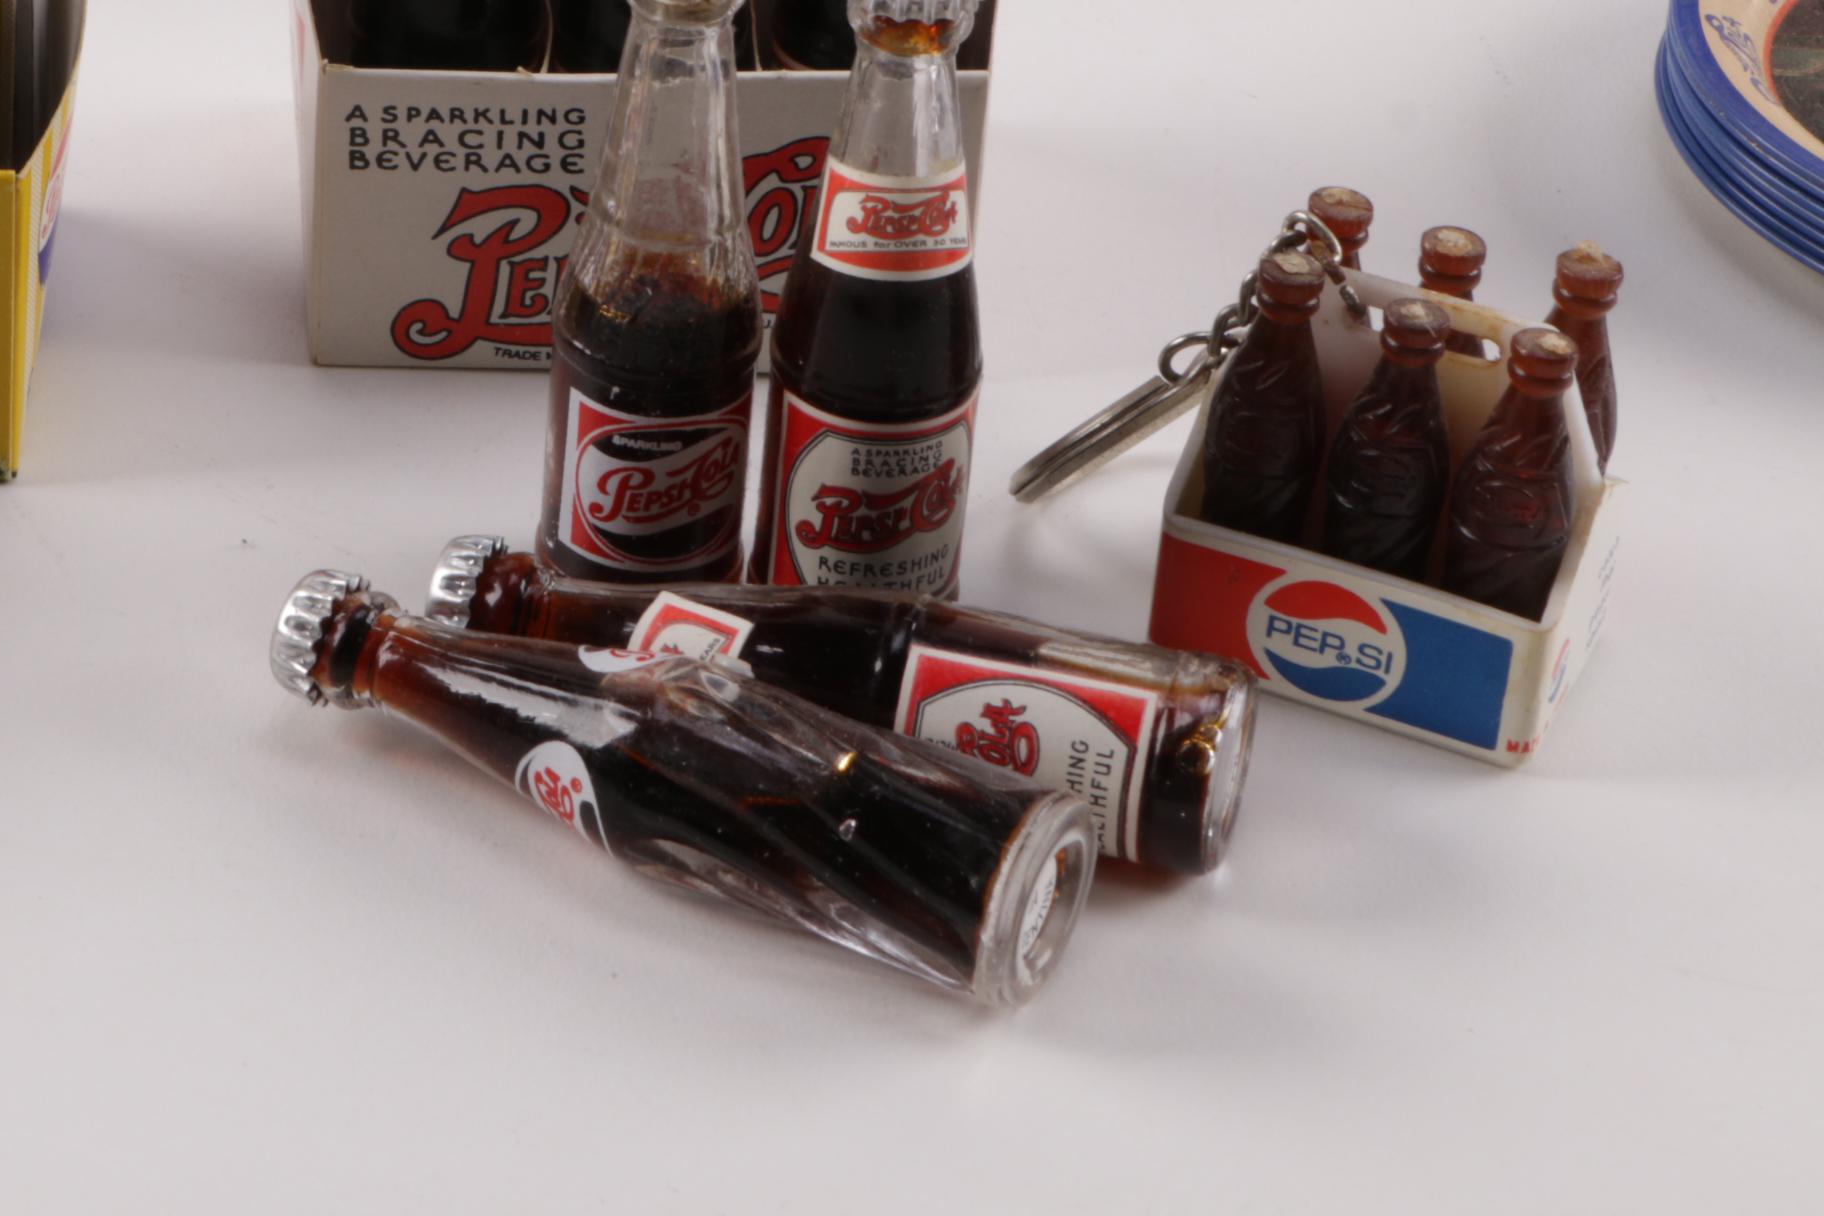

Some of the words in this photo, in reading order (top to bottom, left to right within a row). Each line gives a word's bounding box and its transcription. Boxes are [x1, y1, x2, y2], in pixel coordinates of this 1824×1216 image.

[344, 104, 369, 123] A
[379, 105, 587, 126] SPARKLING
[349, 126, 586, 151] BRACING
[348, 149, 587, 174] BEVERAGE
[829, 240, 868, 249] FAMOUS
[894, 239, 927, 249] OVER
[493, 346, 543, 361] TRADE
[611, 434, 683, 452] SPARKLING
[865, 440, 943, 458] SPARKLING
[851, 449, 943, 468] BRACING
[818, 543, 949, 578] REFRESHING
[699, 637, 722, 662] EARS
[1266, 614, 1394, 676] PEPSI
